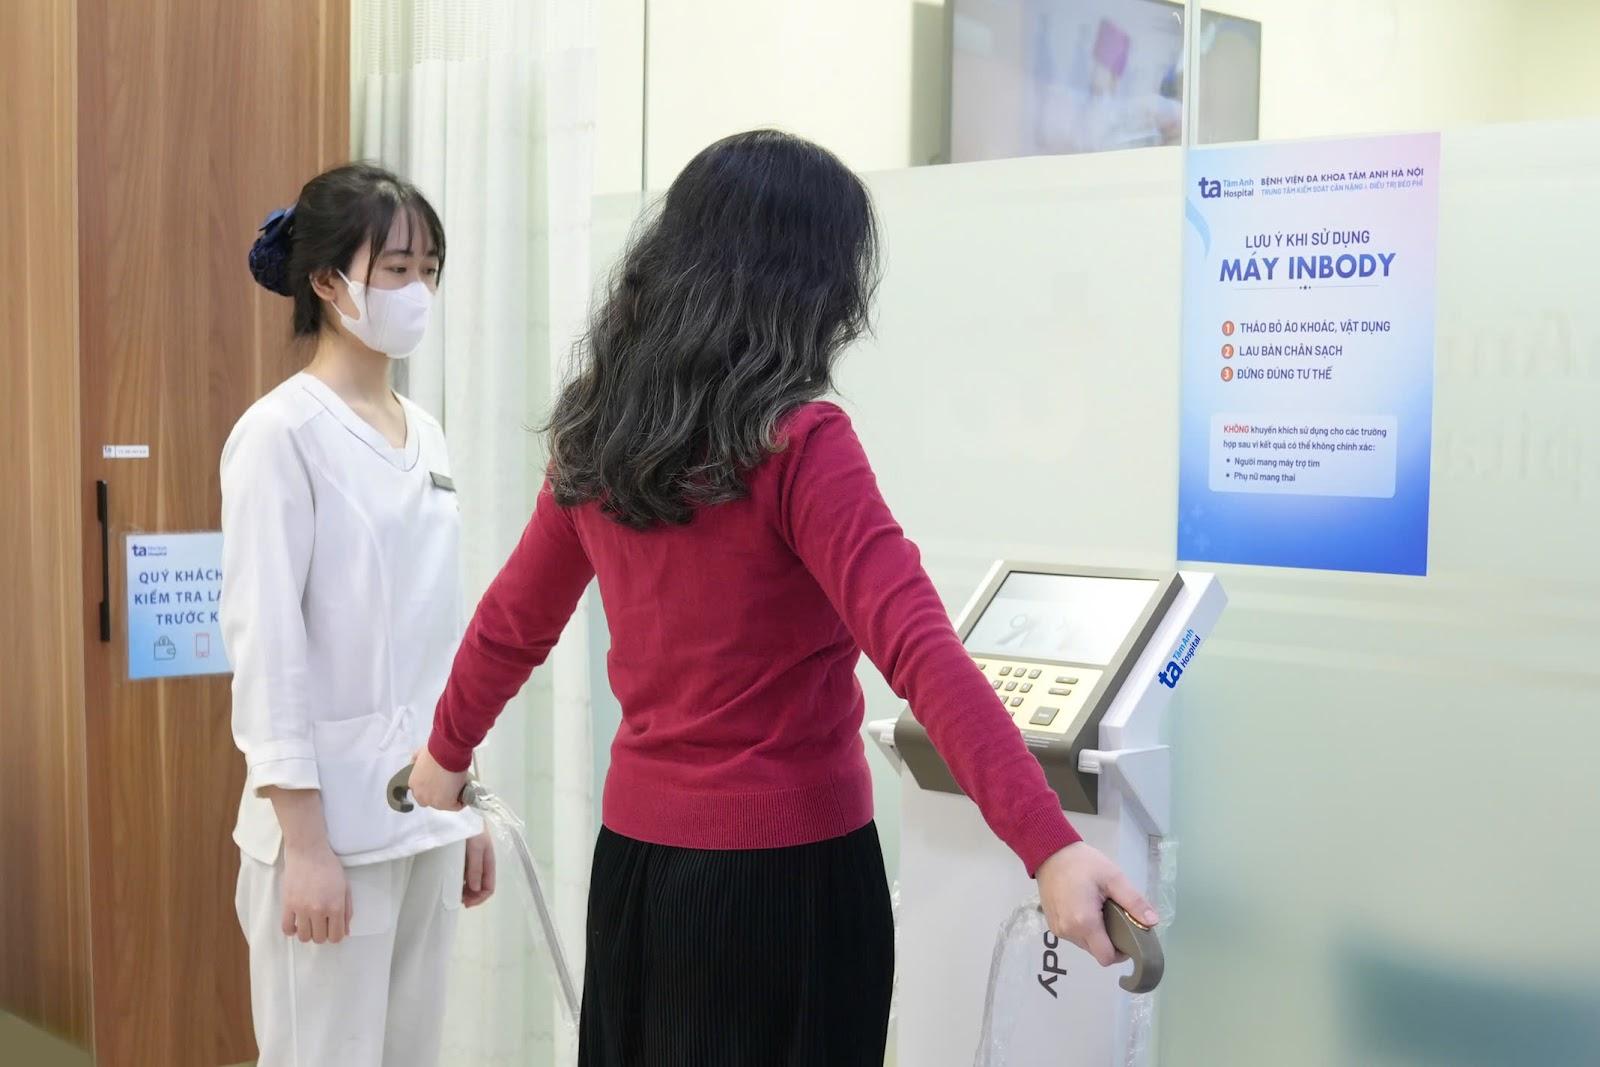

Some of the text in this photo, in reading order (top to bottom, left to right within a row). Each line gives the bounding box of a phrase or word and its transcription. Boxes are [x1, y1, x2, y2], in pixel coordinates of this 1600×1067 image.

[1239, 178, 1254, 187] Anh
[1261, 166, 1424, 187] BỆNH VIỆN ĐA KHOA TÂM ANH HÀ NỘI
[1198, 177, 1221, 198] ta
[1223, 189, 1254, 198] Hospital
[1245, 228, 1370, 248] LƯU Ý KHI SỬ DỤNG
[1219, 252, 1396, 282] MÁY INBODY
[1240, 320, 1267, 333] THÁO
[1268, 318, 1282, 333] BỎ
[1284, 319, 1298, 333] ÁO
[1300, 319, 1337, 334] KHOÁC,
[1340, 318, 1359, 335] VẬT
[1361, 320, 1391, 335] DỤNG
[1239, 345, 1260, 356] LAU
[1261, 343, 1282, 356] BÀN
[1284, 342, 1313, 356] CHÂN
[1314, 345, 1343, 359] SẠCH
[1237, 365, 1265, 380] ĐỨNG
[1267, 365, 1295, 380] ĐÚNG
[1297, 367, 1311, 380] TƯ
[1312, 365, 1333, 380] THẾ
[1223, 423, 1249, 434] KHÔNG
[1251, 426, 1277, 436] khuyến
[1278, 426, 1298, 435] khích
[1310, 427, 1328, 437] dụng
[1330, 427, 1344, 436] cho
[1345, 428, 1359, 436] các
[1223, 440, 1237, 450] hợp
[1260, 440, 1271, 448] kết
[1288, 441, 1297, 449] có
[1312, 441, 1335, 452] không
[1336, 442, 1357, 451] chính
[1234, 457, 1320, 469] Người mang máy trợ tim
[1234, 472, 1296, 483] Phụ nữ mang thai
[132, 544, 147, 557] ta
[139, 567, 223, 585] QUÝ KHÁCH
[134, 589, 170, 605] KIỂM
[175, 590, 203, 603] TRA
[155, 610, 205, 625] TRƯỚC
[1180, 634, 1201, 668] Hospital
[1158, 661, 1183, 689] ta
